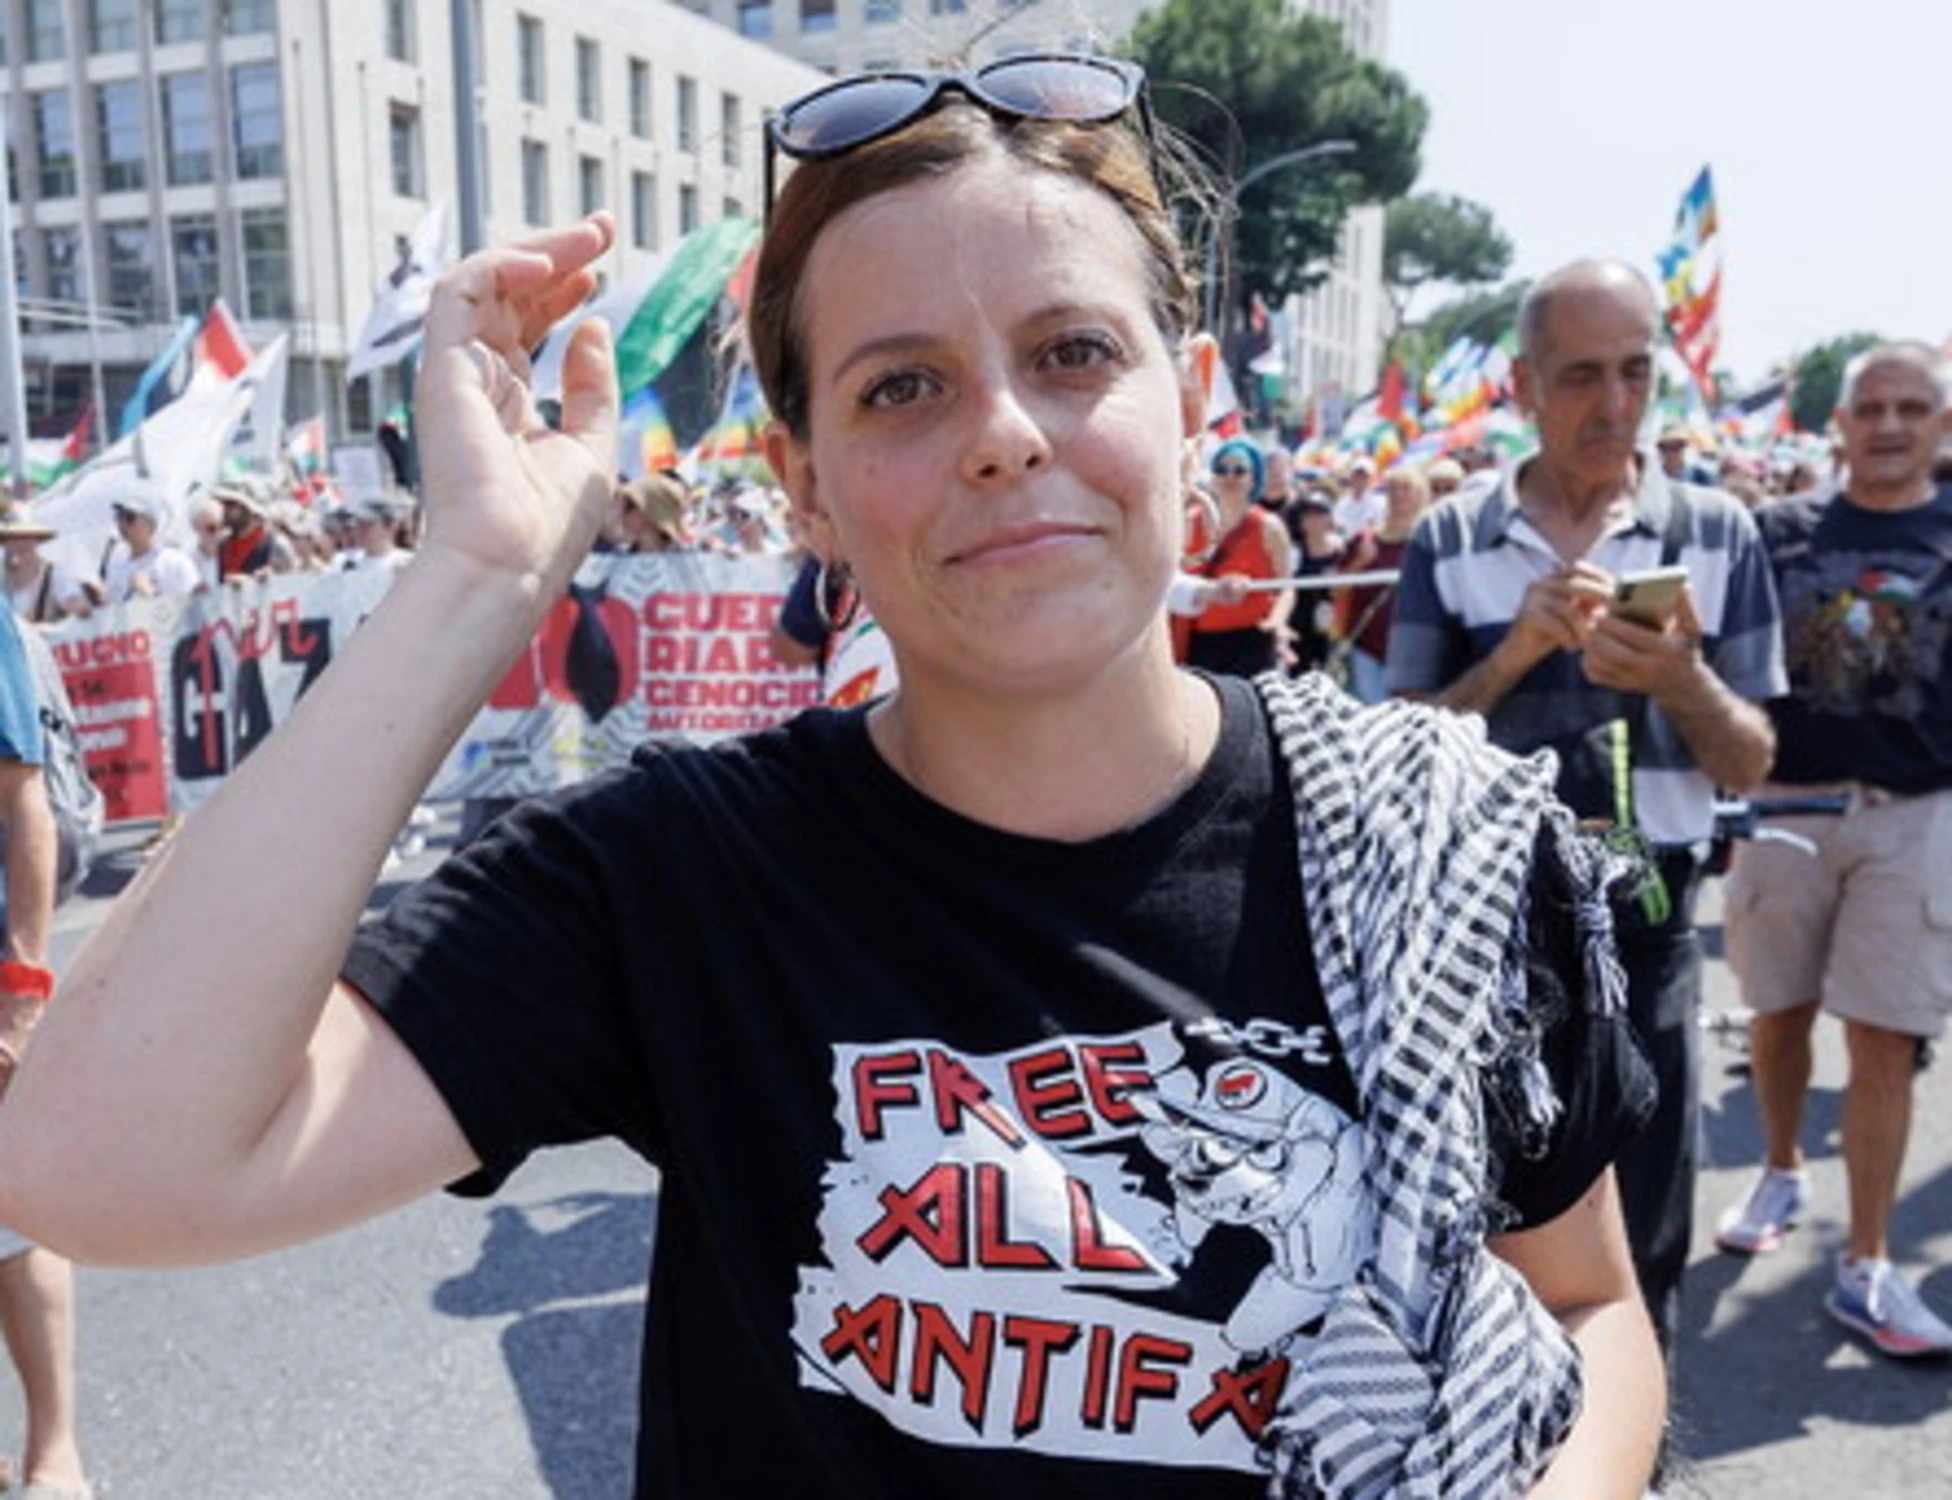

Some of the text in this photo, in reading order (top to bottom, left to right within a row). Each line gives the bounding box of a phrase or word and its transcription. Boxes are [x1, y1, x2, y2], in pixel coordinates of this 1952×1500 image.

[171, 616, 334, 780] GAZ
[646, 635, 780, 674] RIAR
[852, 1042, 1159, 1150] FREE
[856, 1162, 1153, 1272] ALL
[820, 1293, 1290, 1439] ANTIFA
